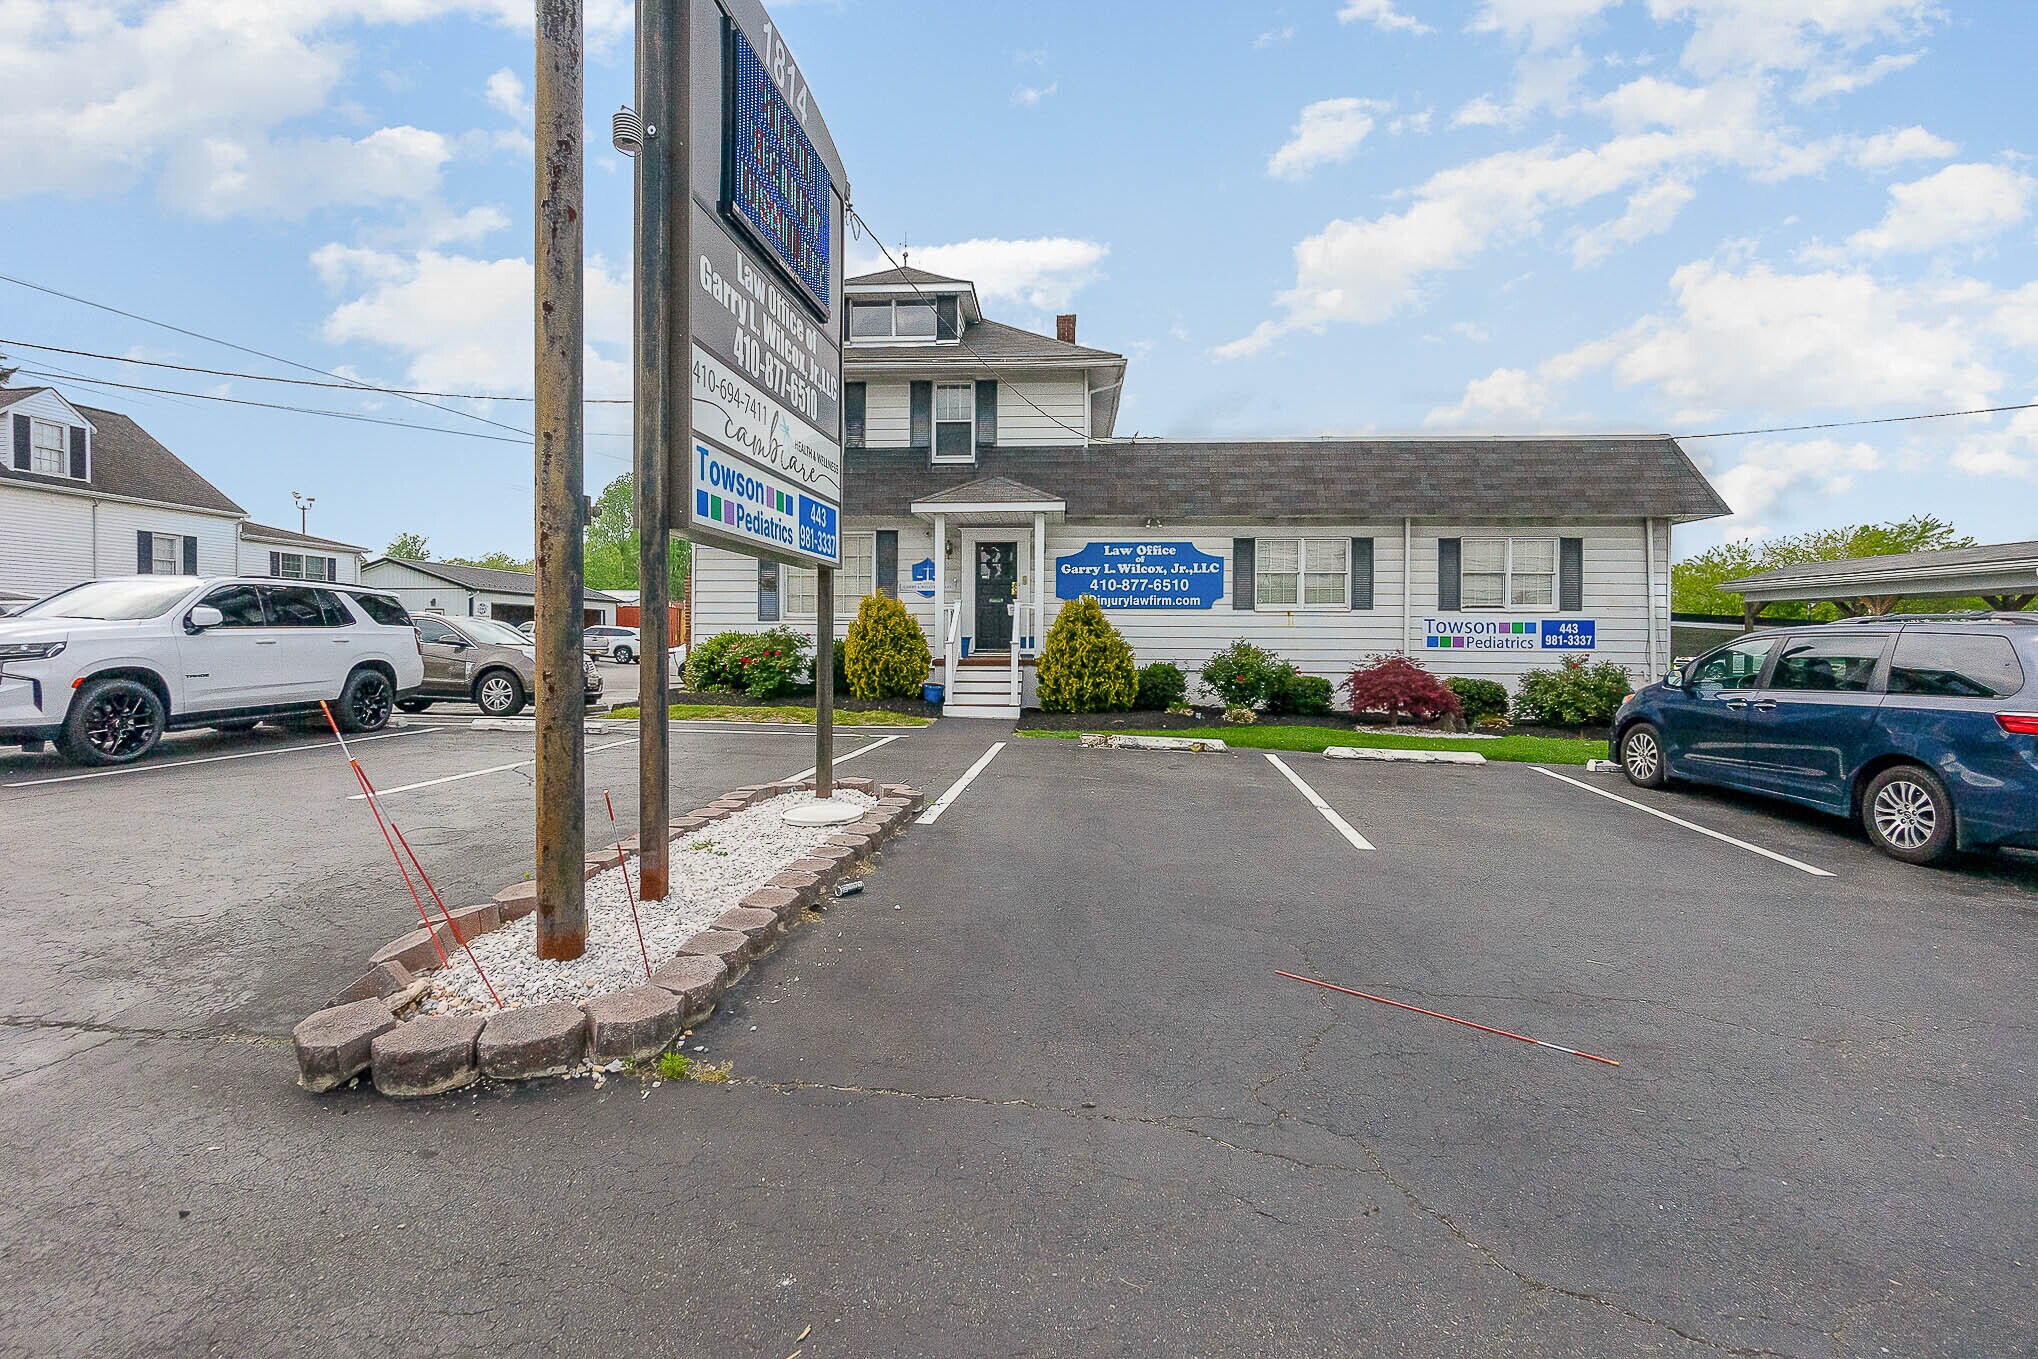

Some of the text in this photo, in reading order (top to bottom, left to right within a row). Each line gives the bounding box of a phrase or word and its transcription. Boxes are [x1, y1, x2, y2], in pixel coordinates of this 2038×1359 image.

[763, 20, 808, 126] 1814
[699, 254, 748, 327] Garry
[749, 299, 761, 337] L.
[736, 250, 767, 306] Law
[768, 284, 804, 342] Office
[805, 327, 817, 356] of
[733, 326, 818, 422] 410-877-6510
[692, 360, 767, 425] 410-694-7411
[794, 440, 812, 459] HEALTH
[696, 445, 765, 505] Towson
[736, 502, 794, 545] Pediatrics
[810, 503, 827, 527] 443
[799, 524, 836, 554] 981-3337
[1103, 545, 1177, 556] Law Office
[1060, 564, 1102, 576] Garry
[1103, 564, 1117, 574] L.
[1117, 563, 1168, 576] Wilcox,
[1089, 578, 1190, 592] 410-877-6510
[1424, 618, 1497, 635] Towson
[1559, 623, 1579, 634] 443
[1466, 636, 1534, 649] Pediatrics
[1545, 634, 1593, 646] 981-3337
